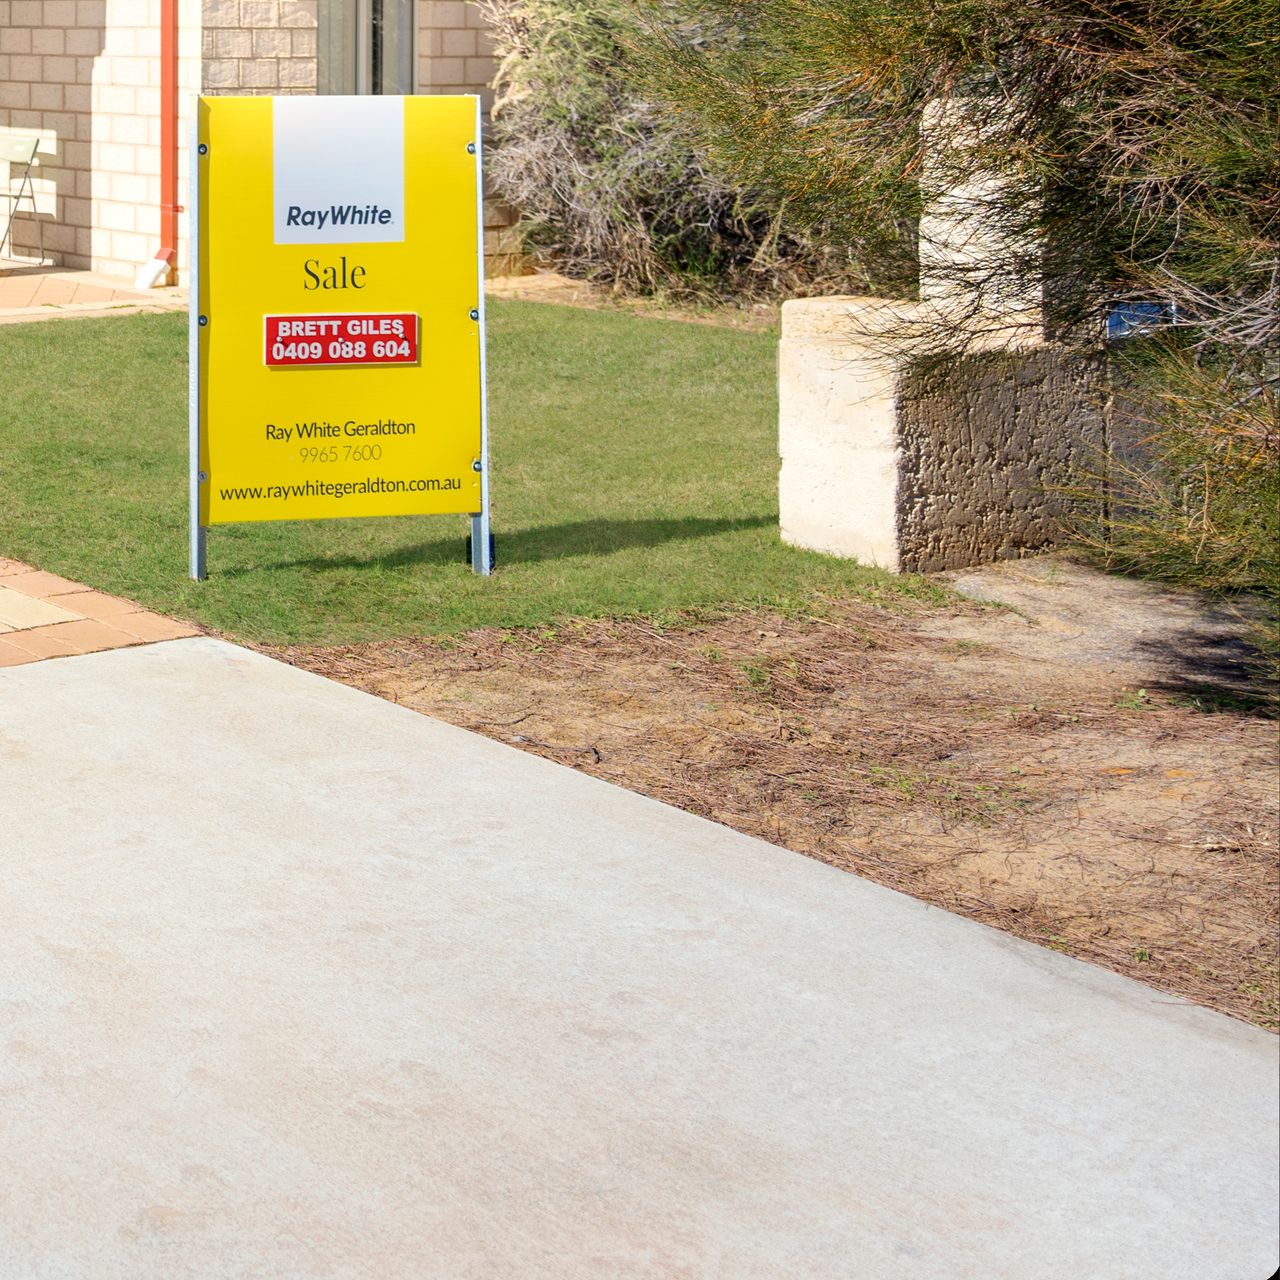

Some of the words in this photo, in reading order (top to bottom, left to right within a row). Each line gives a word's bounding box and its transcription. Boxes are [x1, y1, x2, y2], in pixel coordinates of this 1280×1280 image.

[303, 256, 367, 291] Sale
[278, 320, 342, 337] BRETT
[346, 319, 404, 336] GILES
[272, 342, 323, 360] 0409
[328, 340, 367, 359] 088
[372, 340, 411, 358] 604
[266, 424, 292, 442] Ray
[296, 421, 340, 439] White
[343, 419, 416, 437] Geraldton
[299, 447, 338, 463] 9965
[342, 444, 382, 461] 7600
[220, 476, 461, 500] www.raywhitegeraldton.com.au
